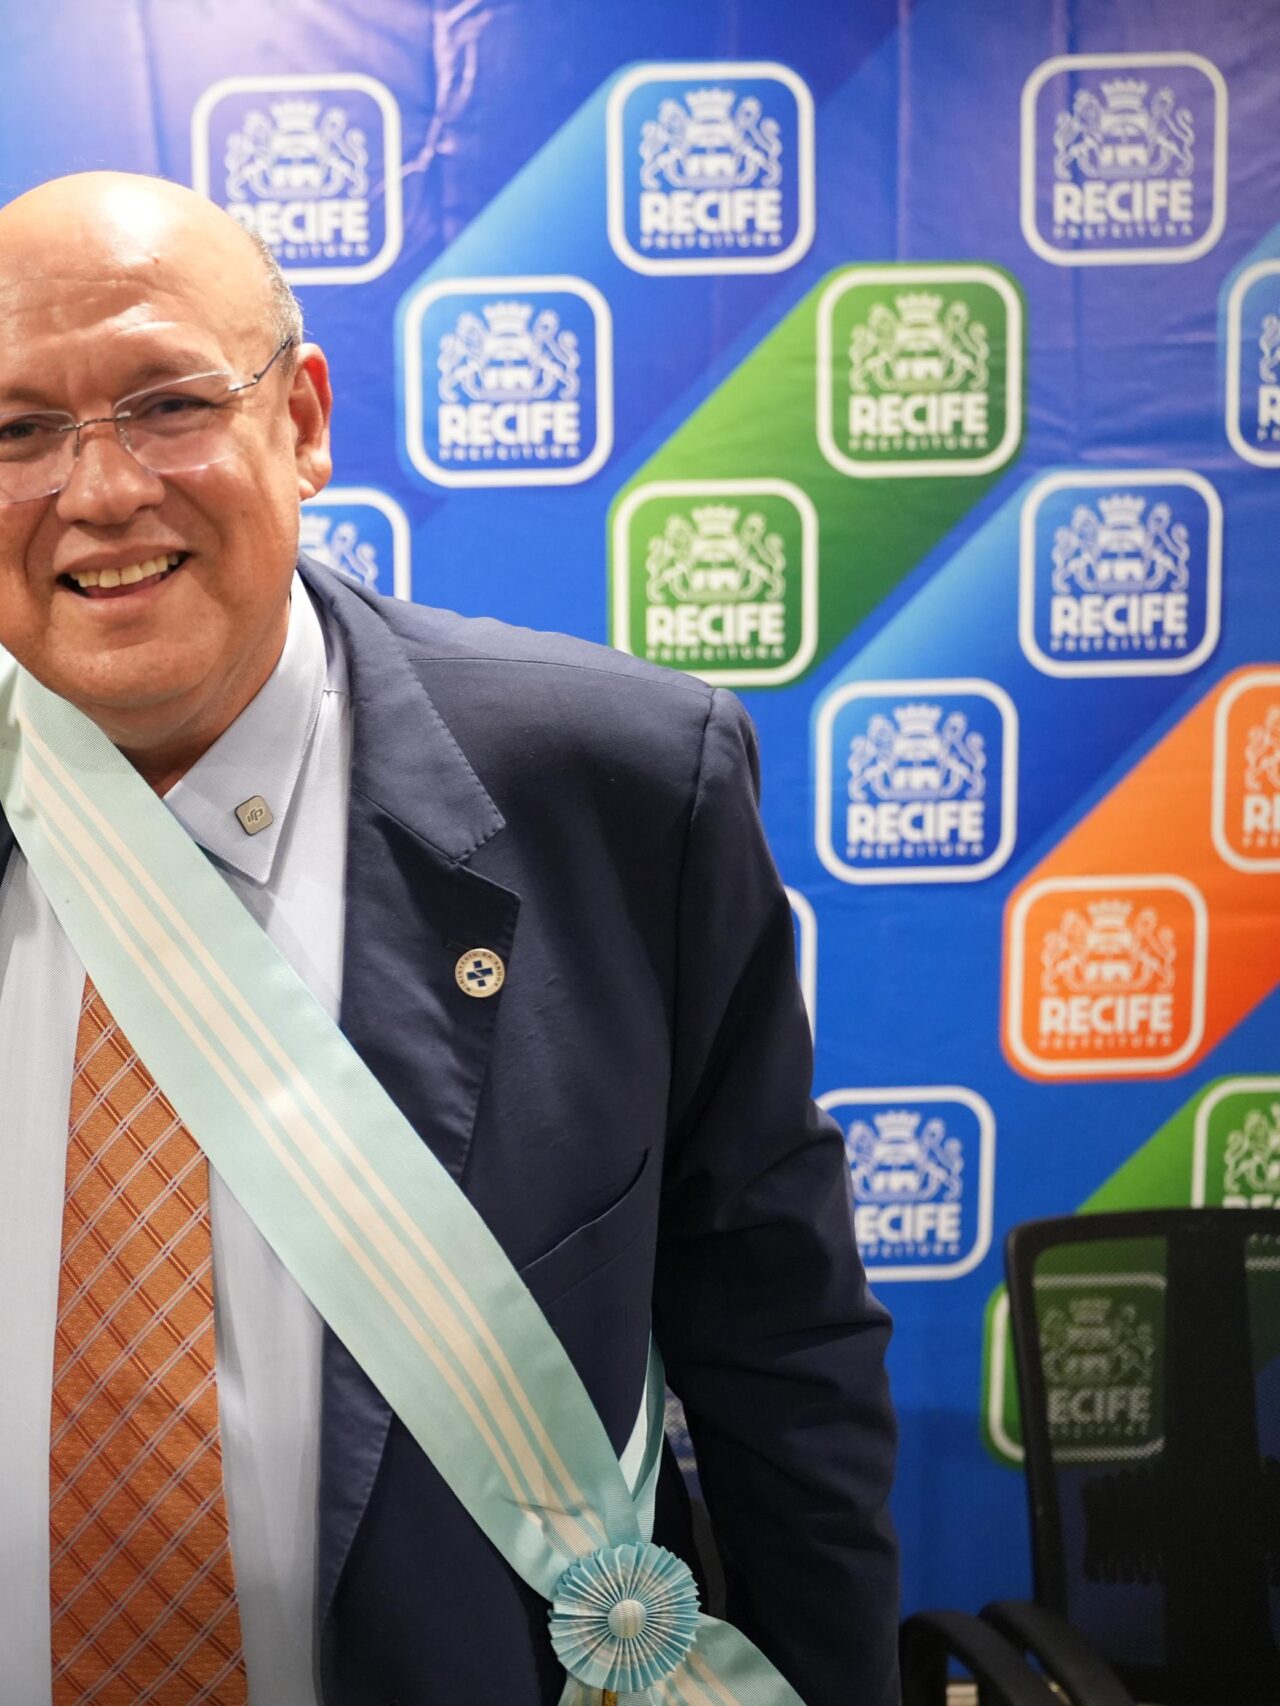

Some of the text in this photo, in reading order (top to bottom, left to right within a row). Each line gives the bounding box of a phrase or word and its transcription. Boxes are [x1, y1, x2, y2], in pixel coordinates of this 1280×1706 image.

[640, 188, 782, 235] RECIFE
[1053, 179, 1193, 225] RECIFE
[438, 402, 580, 447] RECIFE
[849, 392, 988, 436] RECIFE
[646, 602, 785, 647] RECIFE
[1051, 592, 1188, 638] RECIFE
[847, 801, 985, 844] RECIFE
[1039, 994, 1174, 1035] RECIFE
[854, 1203, 962, 1244] ECIFE
[1047, 1386, 1152, 1424] ECIFE
